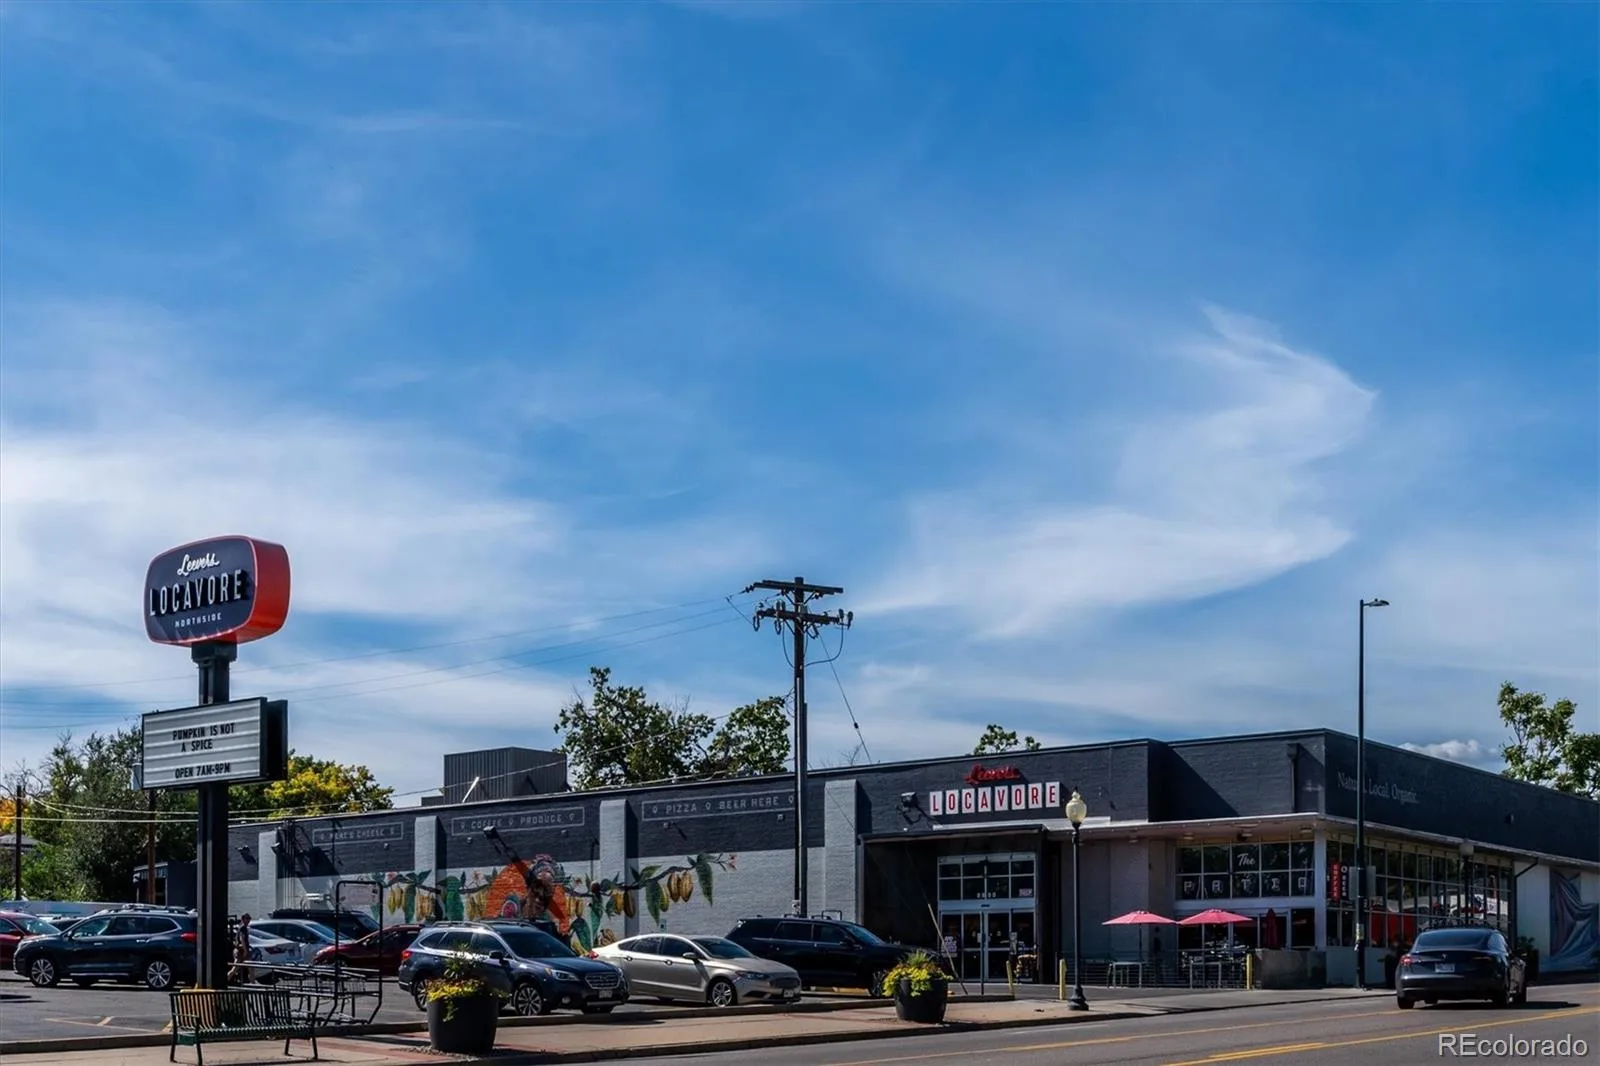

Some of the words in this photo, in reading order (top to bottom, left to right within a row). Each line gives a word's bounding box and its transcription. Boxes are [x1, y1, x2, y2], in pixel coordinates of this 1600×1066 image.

[177, 553, 220, 577] Leevers
[150, 569, 242, 617] LOCAVORE
[175, 612, 222, 629] NORTHSIDE
[172, 726, 206, 741] PUMPKIN
[210, 724, 219, 737] IS
[220, 722, 236, 735] NOT
[181, 742, 187, 752] A
[191, 738, 214, 751] SPICE
[175, 766, 194, 779] OPEN
[665, 803, 697, 814] PIZZA
[719, 799, 747, 810] BEER
[751, 796, 779, 807] HERE
[932, 785, 1056, 812] LOCAVORE
[520, 813, 562, 825] PRODUCE
[1236, 853, 1256, 866] The
